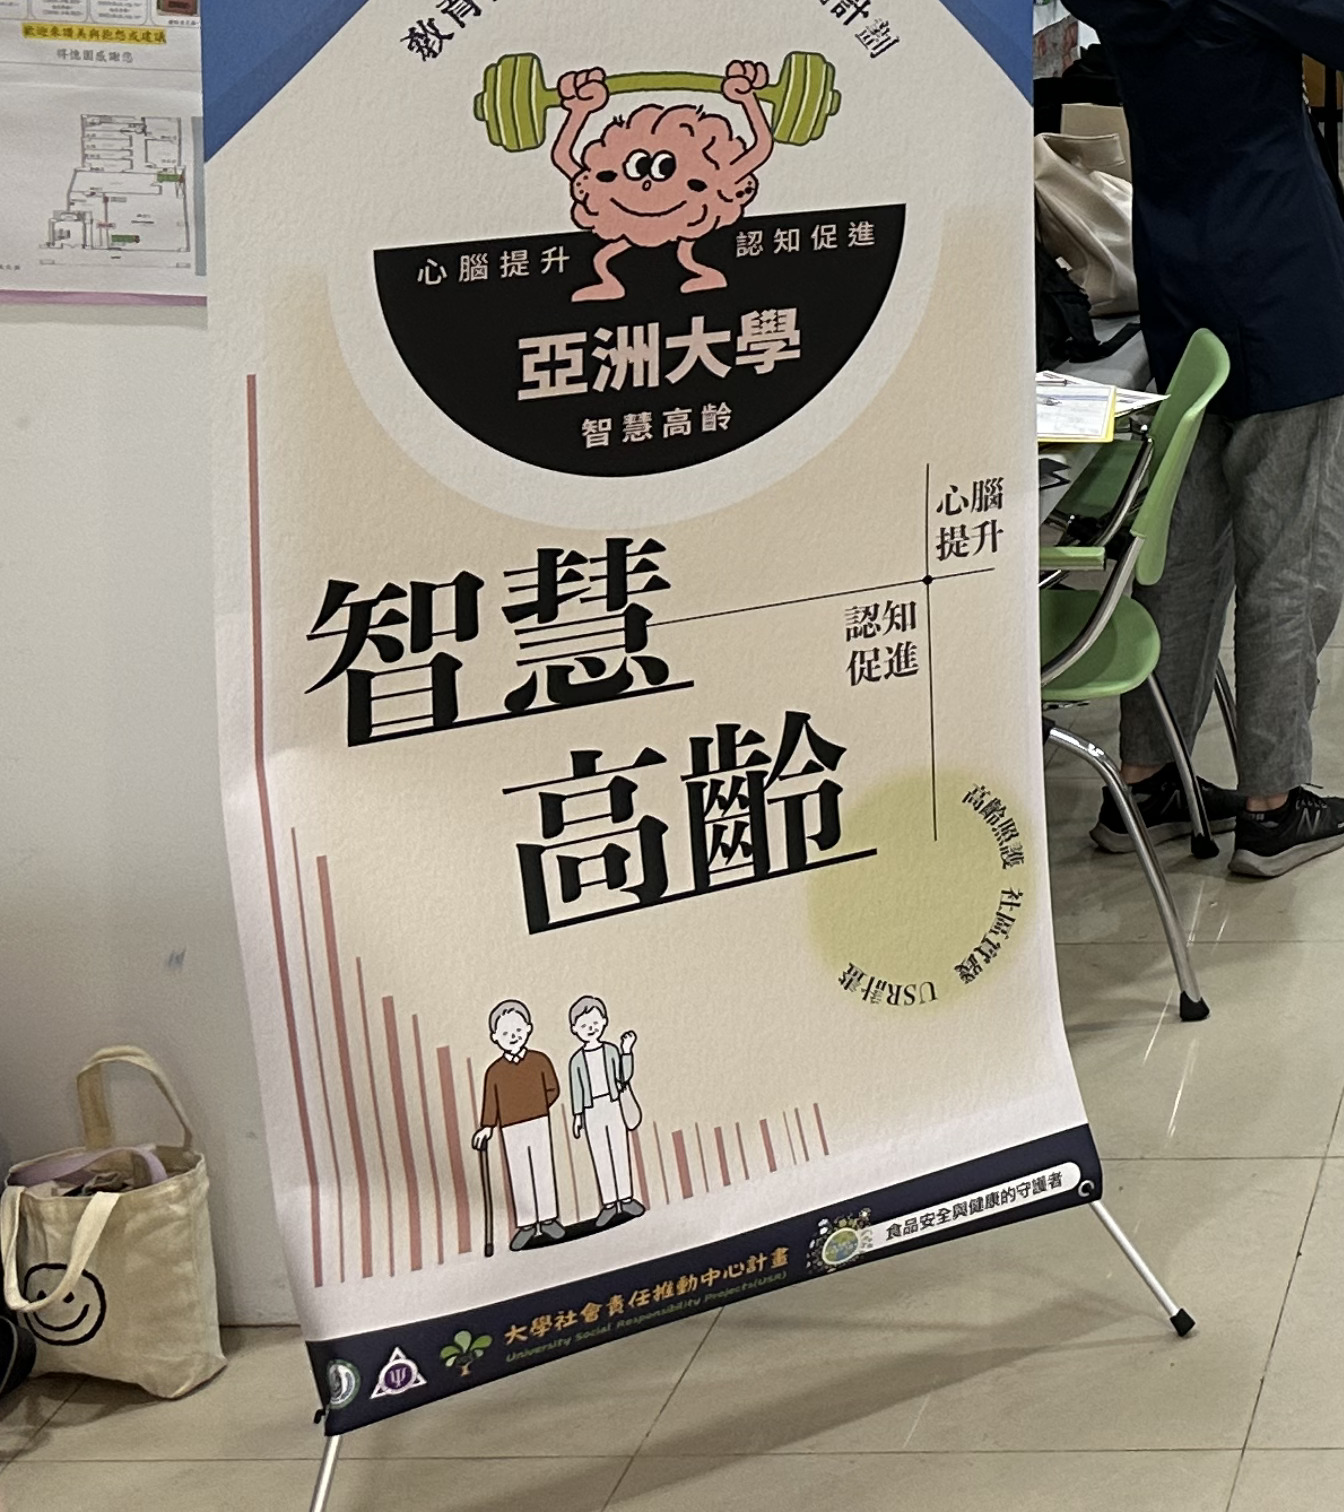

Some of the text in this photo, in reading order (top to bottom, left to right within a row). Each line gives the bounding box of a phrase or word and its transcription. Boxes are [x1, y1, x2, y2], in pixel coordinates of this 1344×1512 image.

[416, 220, 877, 286] 心腦提升 認知促進
[517, 307, 802, 401] 亞洲大學
[581, 400, 734, 450] 智慧高齡
[936, 476, 1005, 518] 心腦
[935, 518, 1005, 563] 提升
[304, 537, 694, 748] 智慧
[844, 598, 918, 643] 認知
[846, 642, 920, 688] 促進
[502, 709, 878, 935] 高齡
[961, 783, 1025, 870] 高齡照護
[885, 1171, 1064, 1242] 食品安全與健康的守護者
[504, 1246, 790, 1345] 大學社會責任推動中心計畫
[505, 1336, 572, 1364] University
[575, 1323, 612, 1342] Social
[616, 1296, 701, 1330] Responsibility
